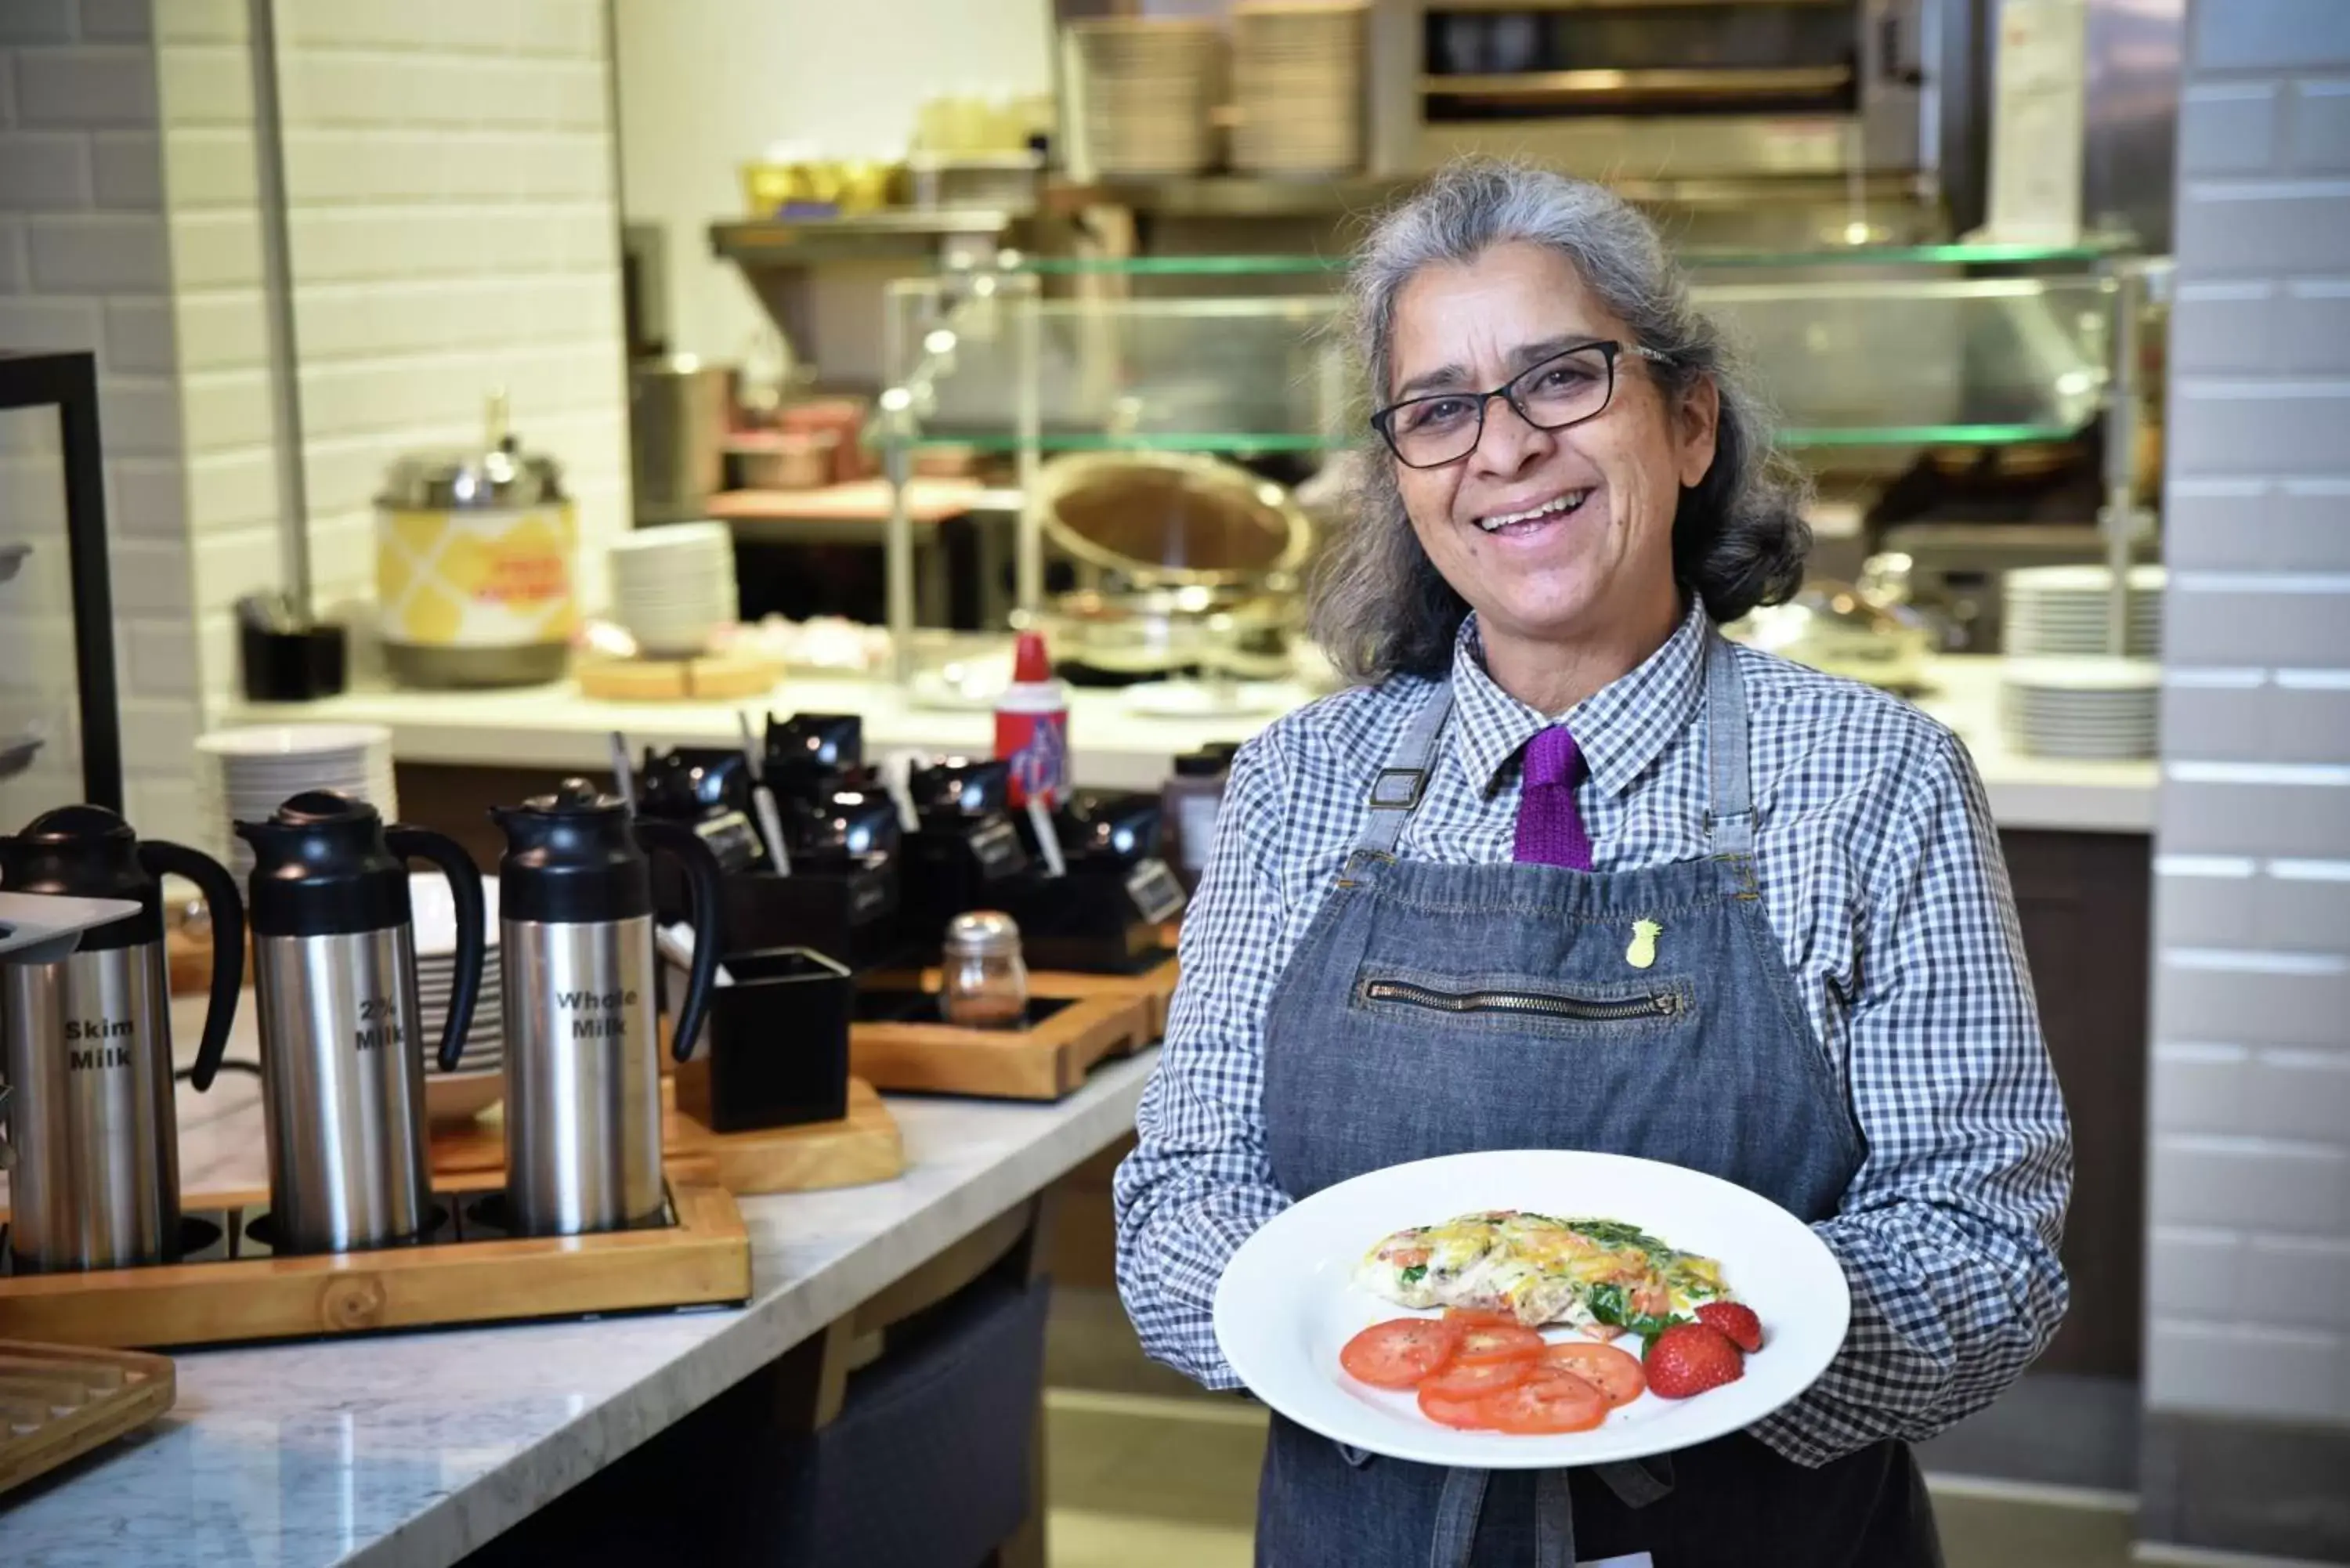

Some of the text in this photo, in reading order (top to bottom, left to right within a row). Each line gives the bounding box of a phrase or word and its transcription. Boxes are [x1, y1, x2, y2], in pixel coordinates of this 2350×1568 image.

[360, 994, 397, 1021] 2%
[555, 988, 638, 1010] Whole
[64, 1018, 135, 1040] Skim
[355, 1024, 405, 1051] Milk
[572, 1017, 627, 1040] Milk
[70, 1046, 132, 1071] Milk
